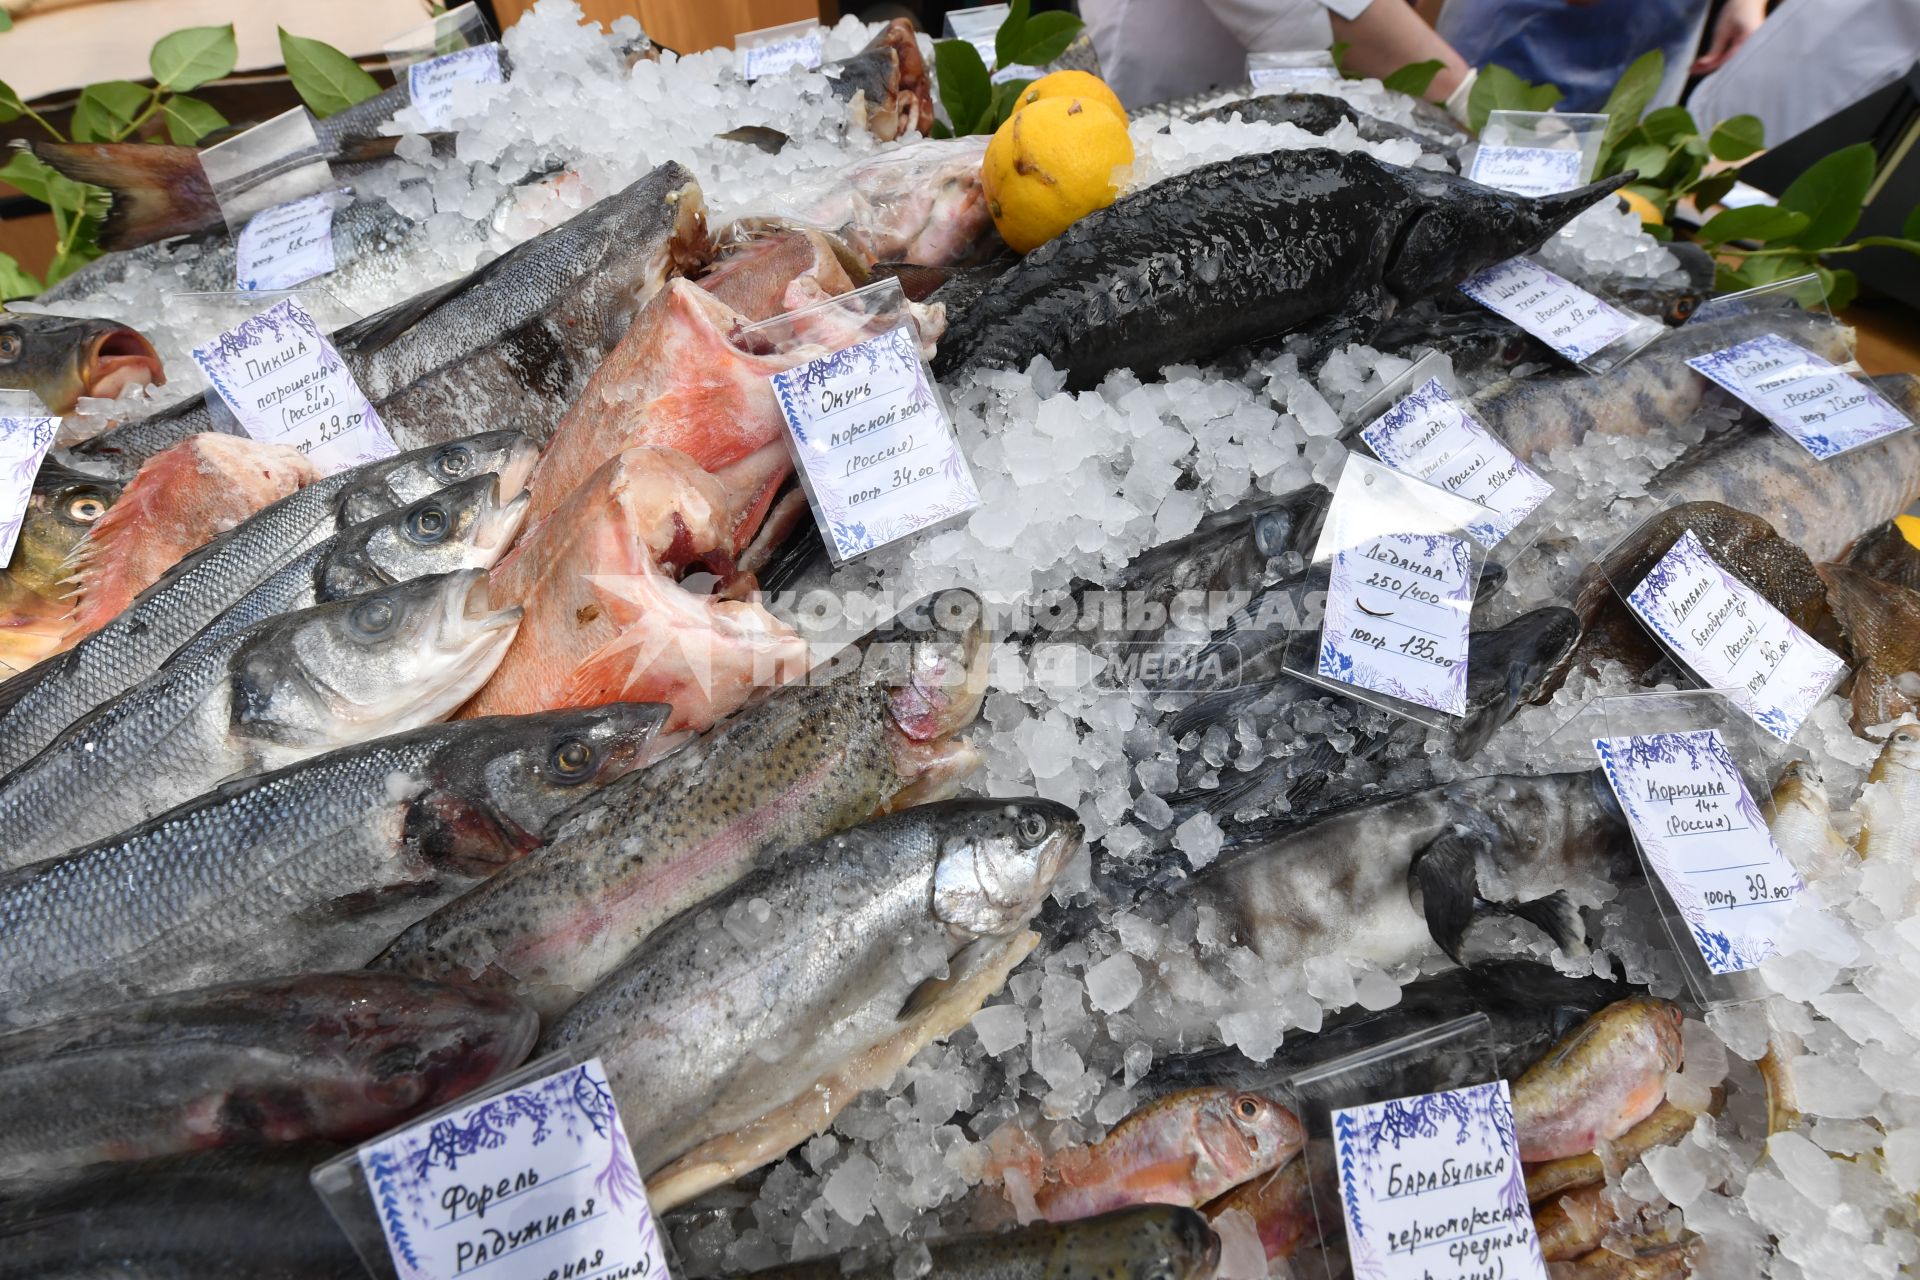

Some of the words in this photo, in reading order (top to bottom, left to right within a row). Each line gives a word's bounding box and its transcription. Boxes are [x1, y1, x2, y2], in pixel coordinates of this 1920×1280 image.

[245, 341, 307, 380] Пикша
[822, 383, 871, 413] Окунь
[320, 414, 361, 442] 29.50
[848, 487, 881, 505] 100гр
[892, 466, 934, 488] 34.00
[1488, 466, 1517, 489] 104.00
[1365, 543, 1443, 580] Ледяная
[1366, 572, 1440, 604] 250/400
[1350, 628, 1386, 650] 100гр
[1399, 635, 1453, 668] 135.00
[1647, 779, 1726, 806] Корюшка
[1695, 799, 1719, 813] 14+
[1666, 814, 1732, 837] (Россия)
[1704, 890, 1737, 910] 100гр
[1745, 873, 1790, 901] 39.00
[442, 1168, 539, 1222] Форель
[1388, 1157, 1505, 1197] Барабулька
[1449, 1227, 1529, 1266] средняя
